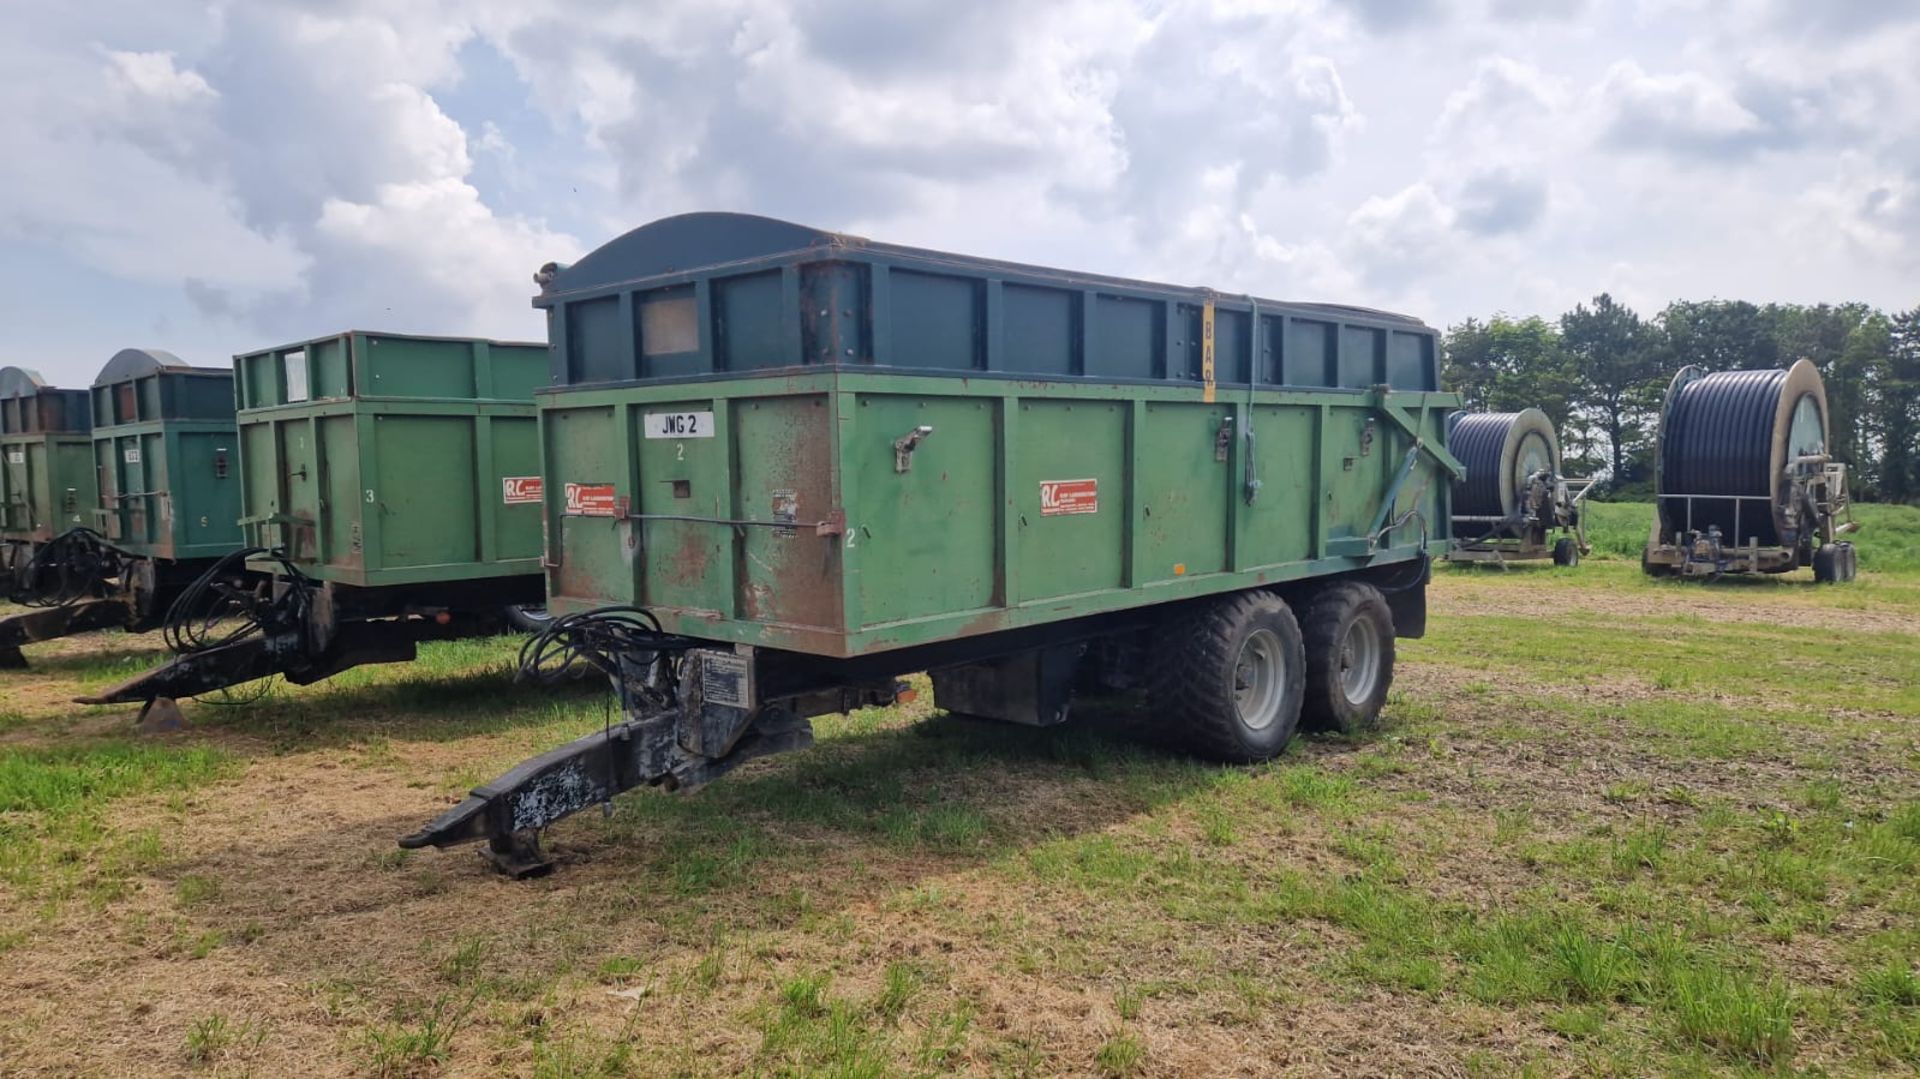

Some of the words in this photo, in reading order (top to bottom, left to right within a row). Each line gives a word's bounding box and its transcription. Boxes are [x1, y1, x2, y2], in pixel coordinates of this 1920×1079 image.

[662, 415, 685, 434] JWG
[688, 414, 697, 433] 2
[676, 442, 685, 461] 2
[365, 489, 375, 503] 3
[846, 528, 856, 548] 2
